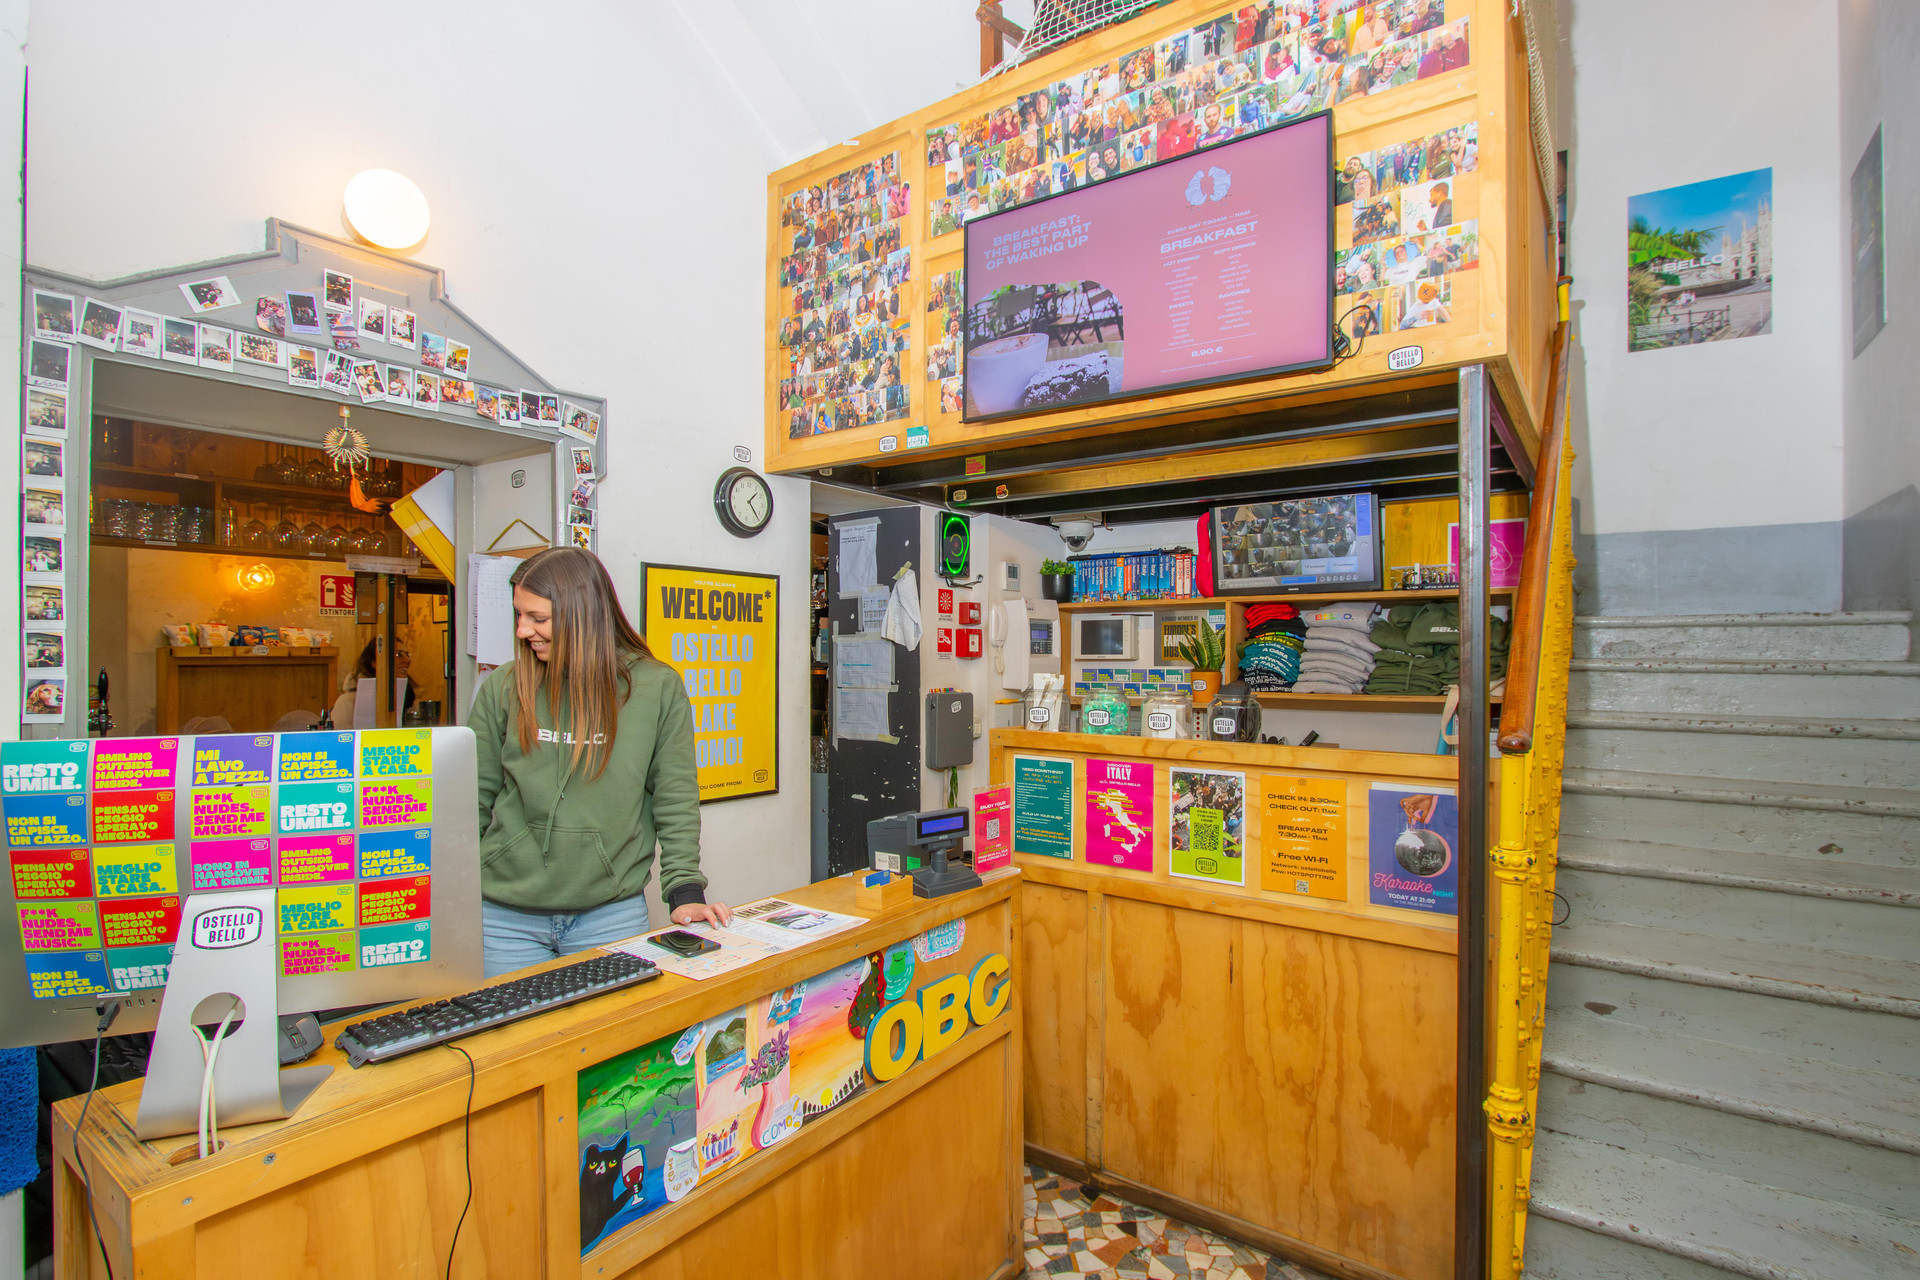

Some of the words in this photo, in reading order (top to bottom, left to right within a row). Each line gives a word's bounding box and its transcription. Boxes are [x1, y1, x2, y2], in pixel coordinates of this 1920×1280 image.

[993, 214, 1080, 246] BREAKFAST:
[1167, 226, 1187, 235] EVERY
[984, 245, 1009, 260] THE
[1013, 234, 1049, 252] BEST
[1052, 222, 1092, 241] PART
[1161, 220, 1258, 253] BREAKFAST
[986, 258, 1004, 270] OF
[1007, 242, 1064, 264] WAKING
[1067, 235, 1088, 248] UP
[1392, 349, 1418, 360] OSTELLO
[1396, 358, 1415, 367] BELLO
[672, 632, 753, 662] OSTELLO
[684, 668, 741, 697] BELLO
[196, 750, 220, 761] MI
[363, 745, 420, 757] MEGLIO
[696, 737, 743, 768] OMO!
[96, 752, 152, 762] SMILING
[282, 752, 311, 762] NON
[363, 755, 410, 766] STARE
[3, 762, 78, 778] RESTO
[96, 761, 153, 771] OUTSIDE
[195, 760, 244, 772] LAVO
[281, 760, 337, 771] CAPISCE
[363, 766, 373, 776] A
[378, 764, 422, 775] CASA.
[95, 769, 170, 780] HANGOVER
[195, 774, 208, 784] A
[213, 771, 269, 783] PEZZI.
[281, 771, 301, 780] UN
[304, 769, 352, 779] CAZZO.
[1107, 767, 1131, 780] ITALY
[3, 777, 82, 792] UMILE.
[95, 779, 142, 789] INSIDE.
[363, 794, 418, 805] NUDES.
[95, 804, 158, 815] PENSAVO
[194, 803, 254, 815] NUDES.
[280, 802, 347, 818] RESTO
[362, 805, 403, 816] SEND
[405, 803, 427, 812] ME
[8, 816, 39, 826] NON
[43, 816, 56, 825] SI
[95, 814, 144, 824] PEGGIO
[194, 814, 238, 825] SEND
[240, 813, 265, 822] ME
[280, 815, 351, 831] UMILE.
[363, 814, 415, 825] MUSIC.
[9, 825, 68, 835] CAPISCE
[95, 822, 158, 832] SPERAVO
[194, 825, 252, 836] MUSIC.
[1278, 825, 1328, 834] BREAKFAST
[10, 836, 31, 845] UN
[33, 834, 86, 844] CAZZO.
[96, 831, 150, 841] MEGLIO.
[14, 863, 74, 872] PENSAVO
[194, 862, 232, 871] SONO
[1301, 866, 1337, 874] ostellobello
[15, 871, 61, 880] PEGGIO
[194, 868, 269, 880] HANGOVER
[1287, 871, 1334, 880] HOTSPOTTING
[16, 879, 75, 888] SPERAVO
[195, 879, 218, 888] MA
[221, 876, 268, 886] DIMMI.
[1373, 873, 1433, 893] Karaoke
[1433, 890, 1454, 898] NIGHT
[18, 888, 69, 897] MEGLIO.
[281, 901, 341, 914] MEGLIO
[202, 913, 254, 930] OSTELLO
[281, 911, 330, 923] STARE
[282, 922, 293, 931] A
[298, 919, 344, 930] CASA.
[208, 928, 245, 943] BELLO
[934, 933, 953, 949] BELLO
[864, 953, 1011, 1082] OBC
[762, 1115, 792, 1144] COMO
